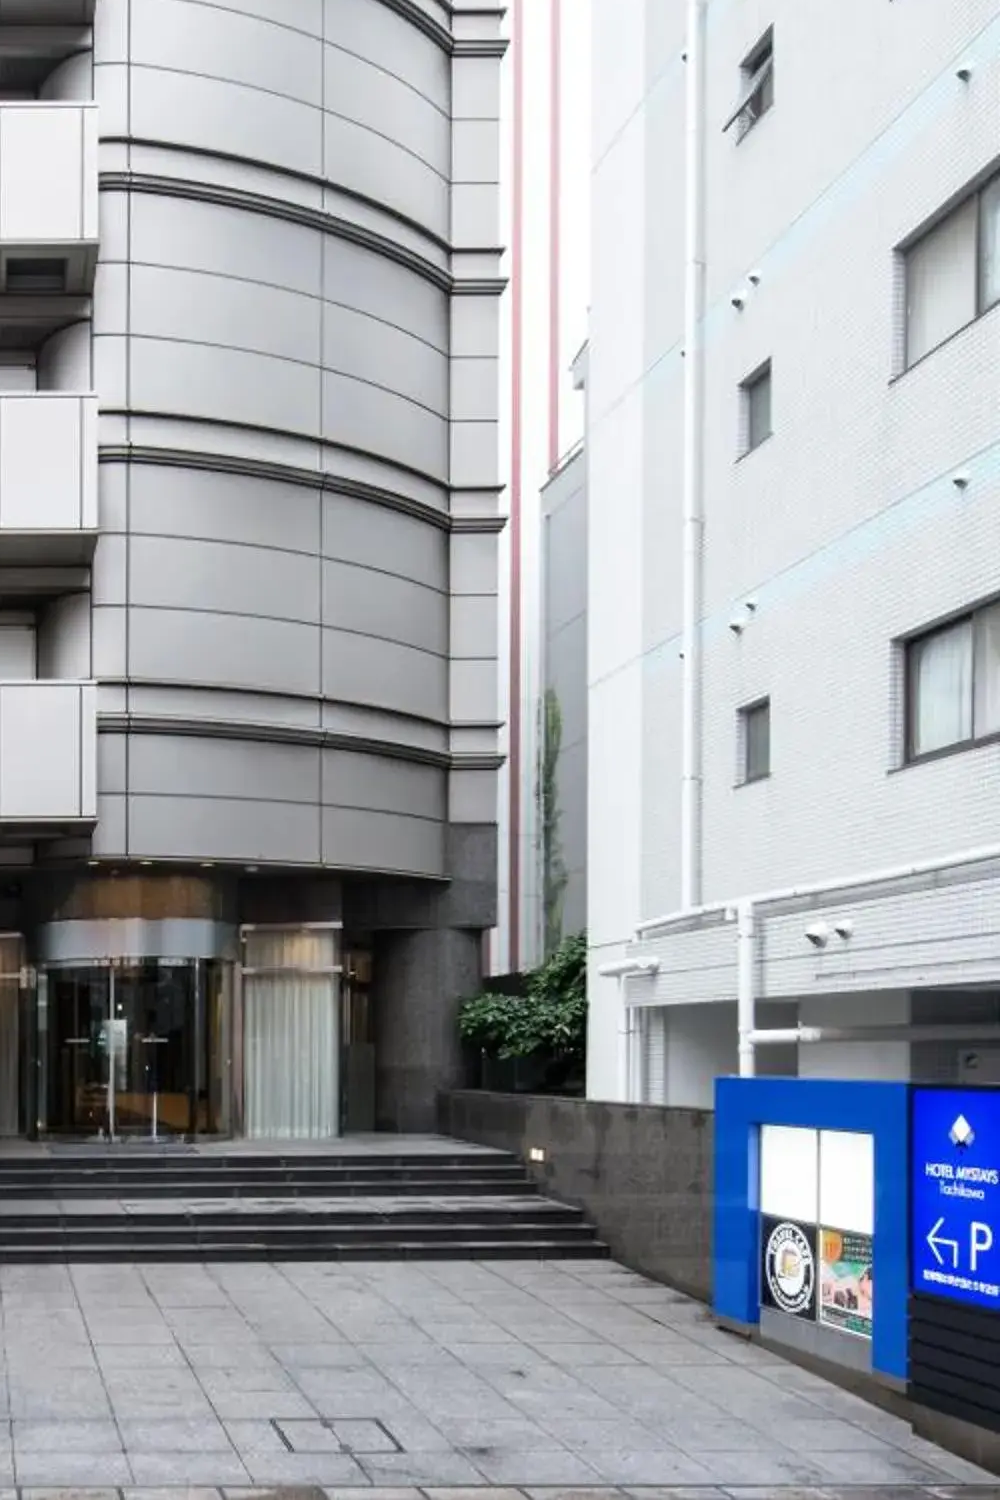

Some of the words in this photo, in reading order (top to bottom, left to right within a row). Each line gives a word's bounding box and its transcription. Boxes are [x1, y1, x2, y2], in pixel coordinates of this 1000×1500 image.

[925, 1162, 955, 1179] HOTEL
[955, 1165, 999, 1185] MYSTAYS
[971, 1221, 993, 1271] P
